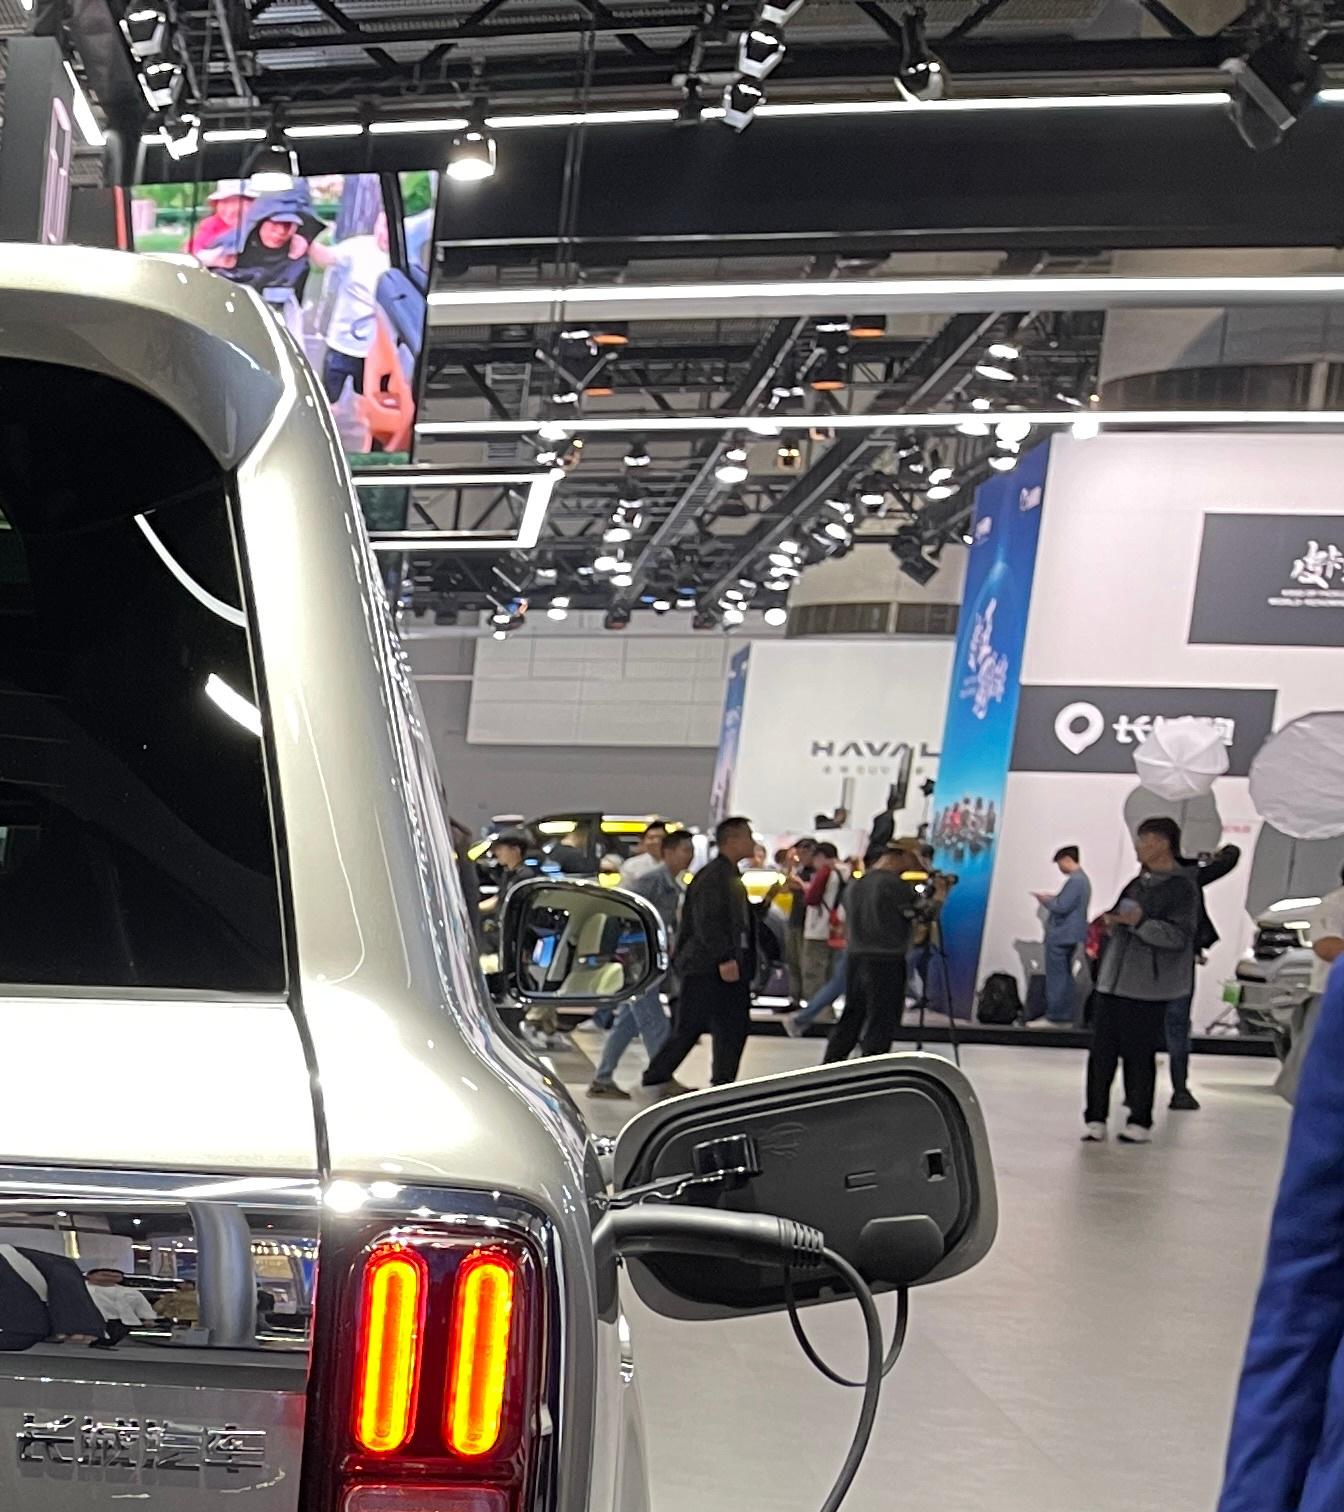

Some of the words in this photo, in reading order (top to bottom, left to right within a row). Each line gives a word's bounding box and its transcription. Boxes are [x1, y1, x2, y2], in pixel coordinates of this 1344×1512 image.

[811, 741, 943, 758] HAVAL
[16, 1413, 266, 1474] 长城汽车
